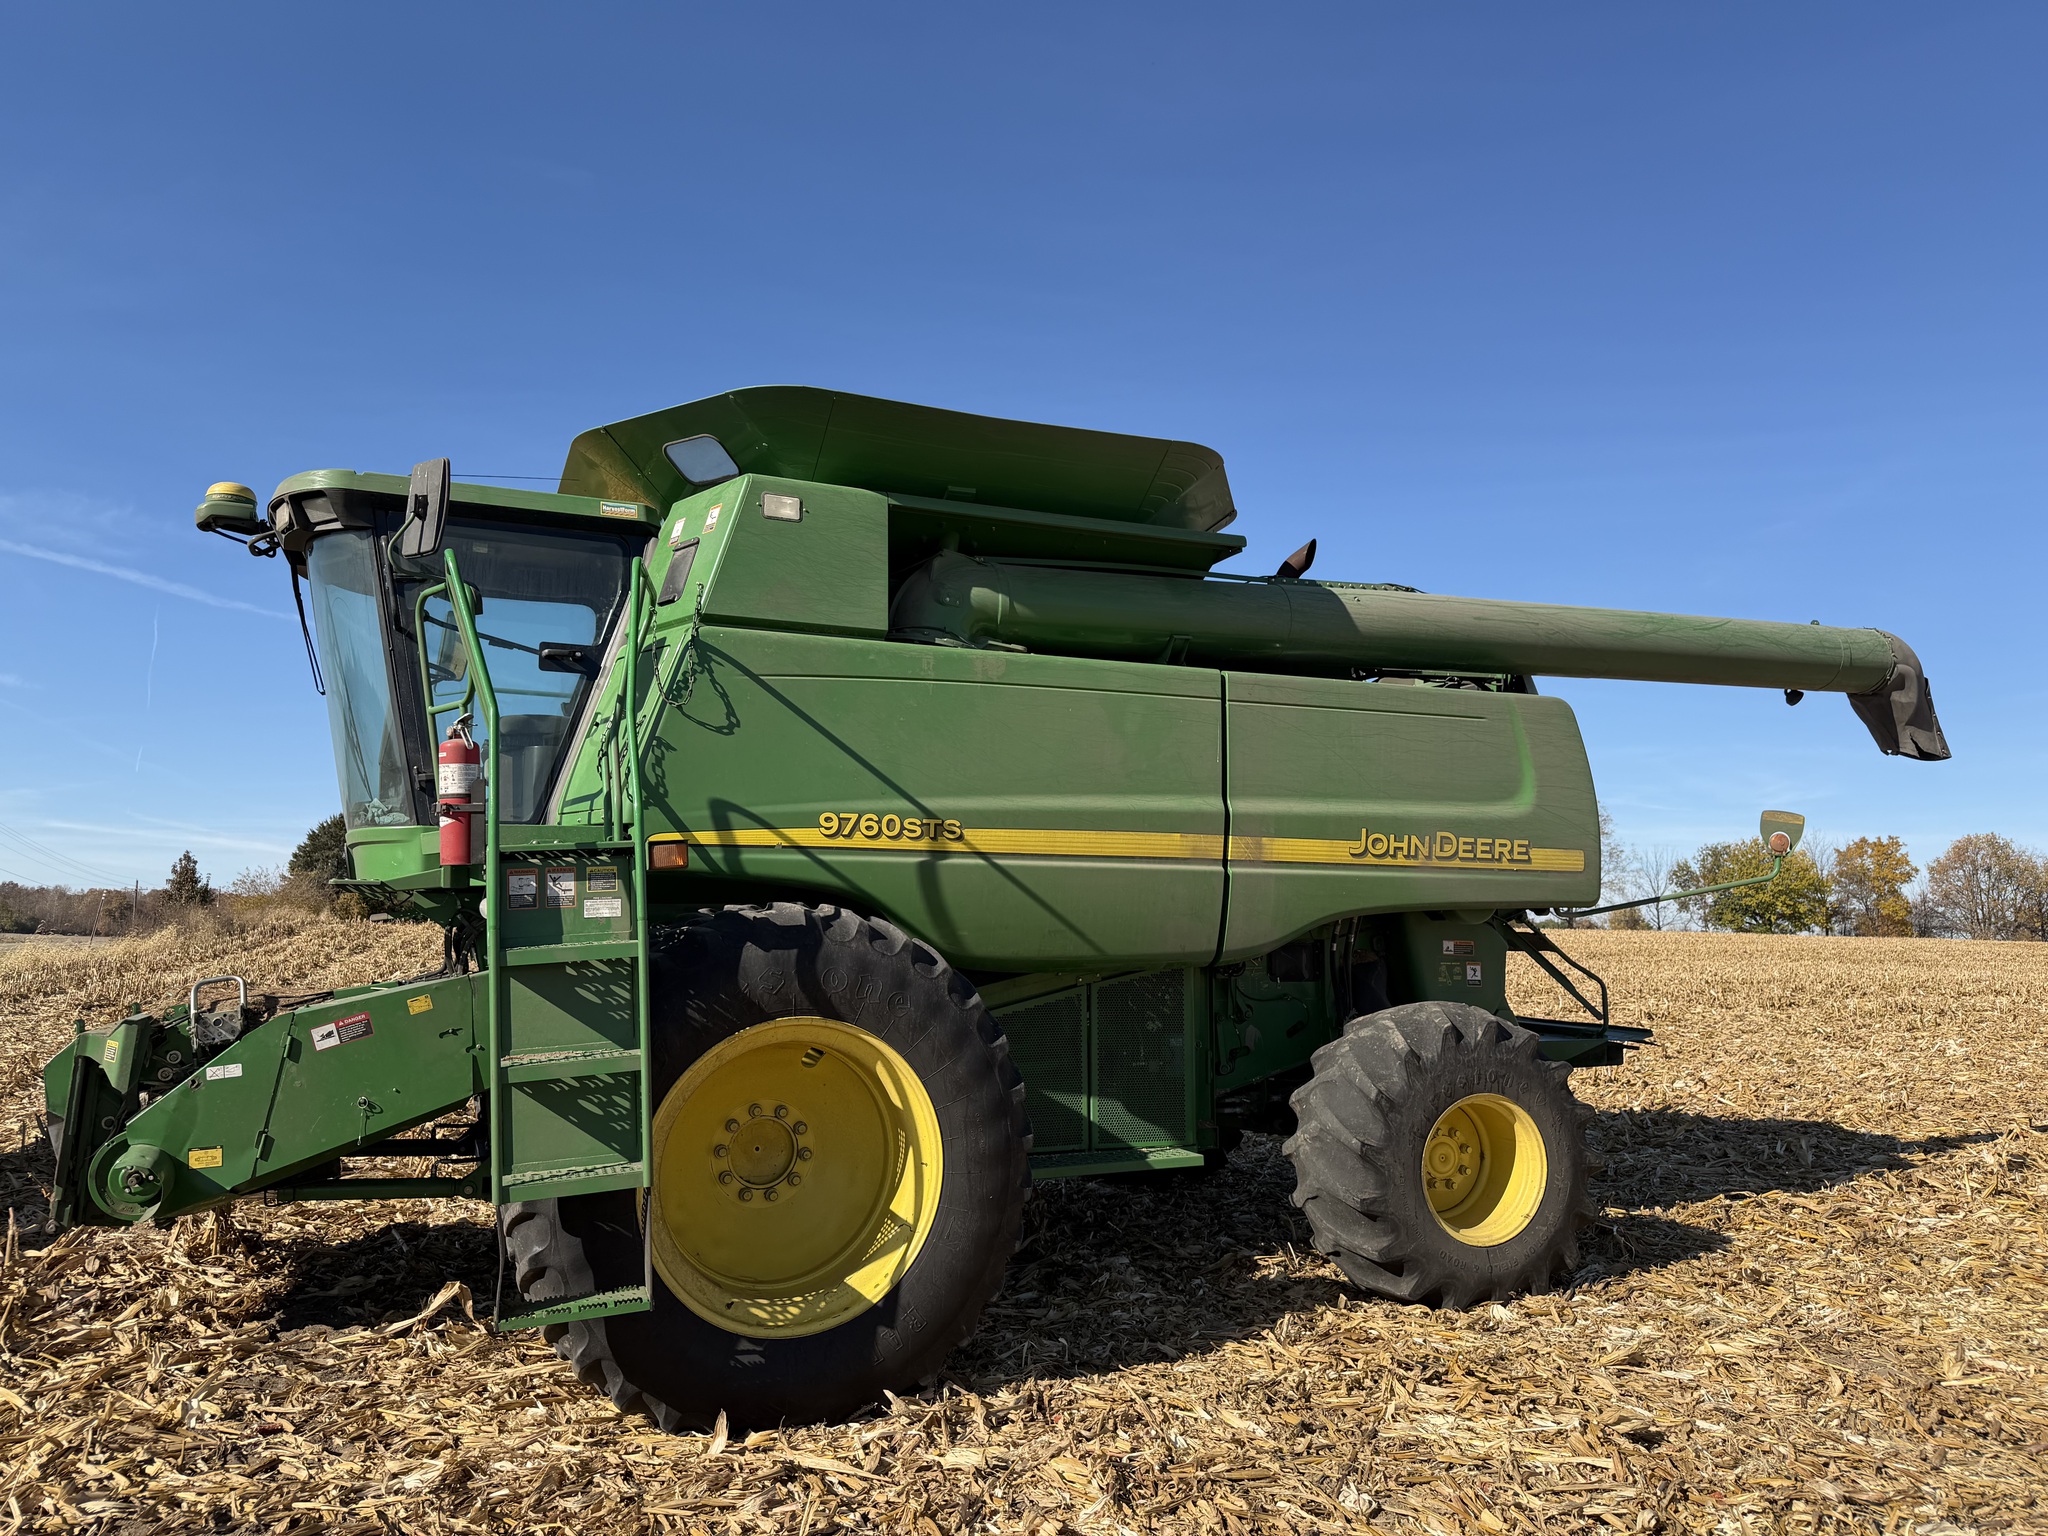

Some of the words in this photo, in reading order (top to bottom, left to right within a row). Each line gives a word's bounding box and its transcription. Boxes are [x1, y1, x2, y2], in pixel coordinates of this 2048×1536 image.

[819, 812, 964, 842] 9760STS
[344, 1014, 366, 1024] DANGER
[1440, 1249, 1467, 1270] ROAD
